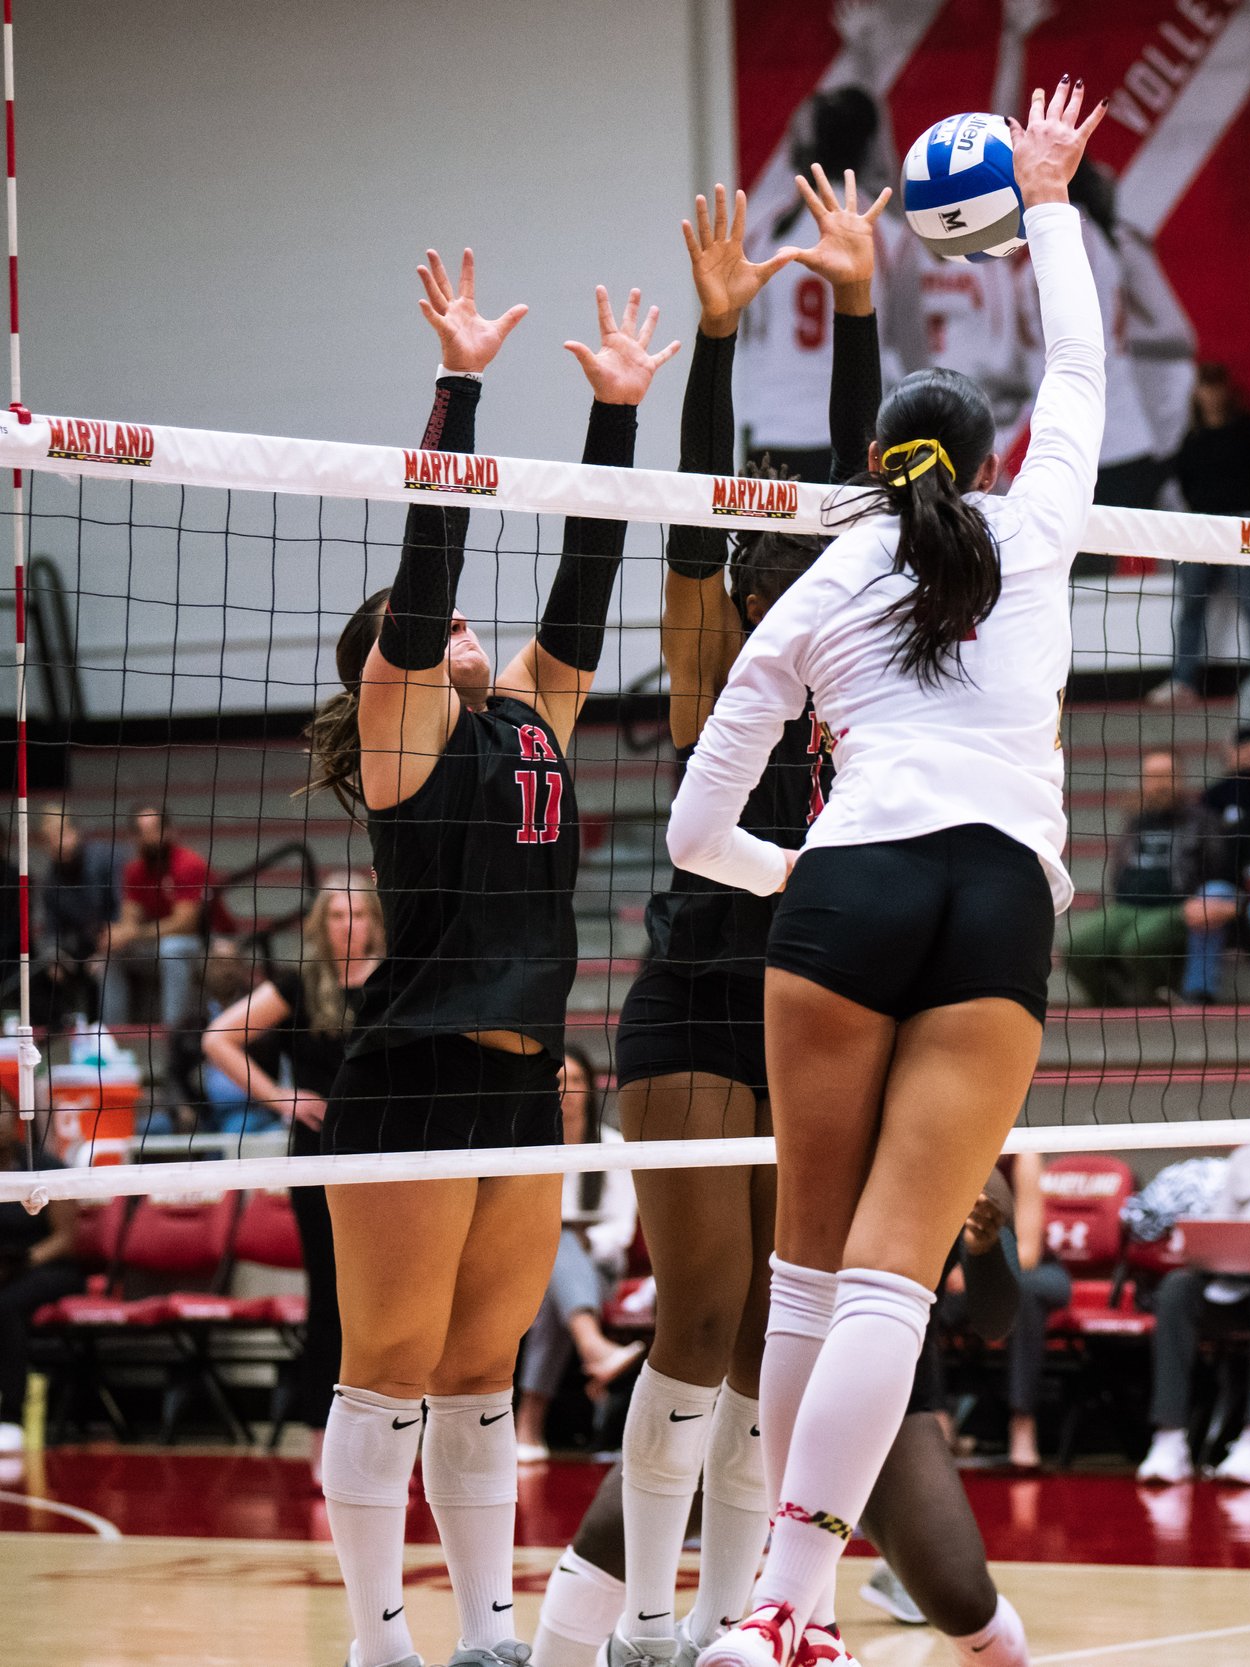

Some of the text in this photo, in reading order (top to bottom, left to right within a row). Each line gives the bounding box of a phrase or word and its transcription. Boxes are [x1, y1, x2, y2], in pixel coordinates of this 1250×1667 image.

[48, 417, 154, 460] MARYLAND
[403, 449, 499, 489] MARYLAND
[713, 476, 798, 513] MARYLAND
[511, 723, 558, 762] R
[514, 770, 563, 844] 11
